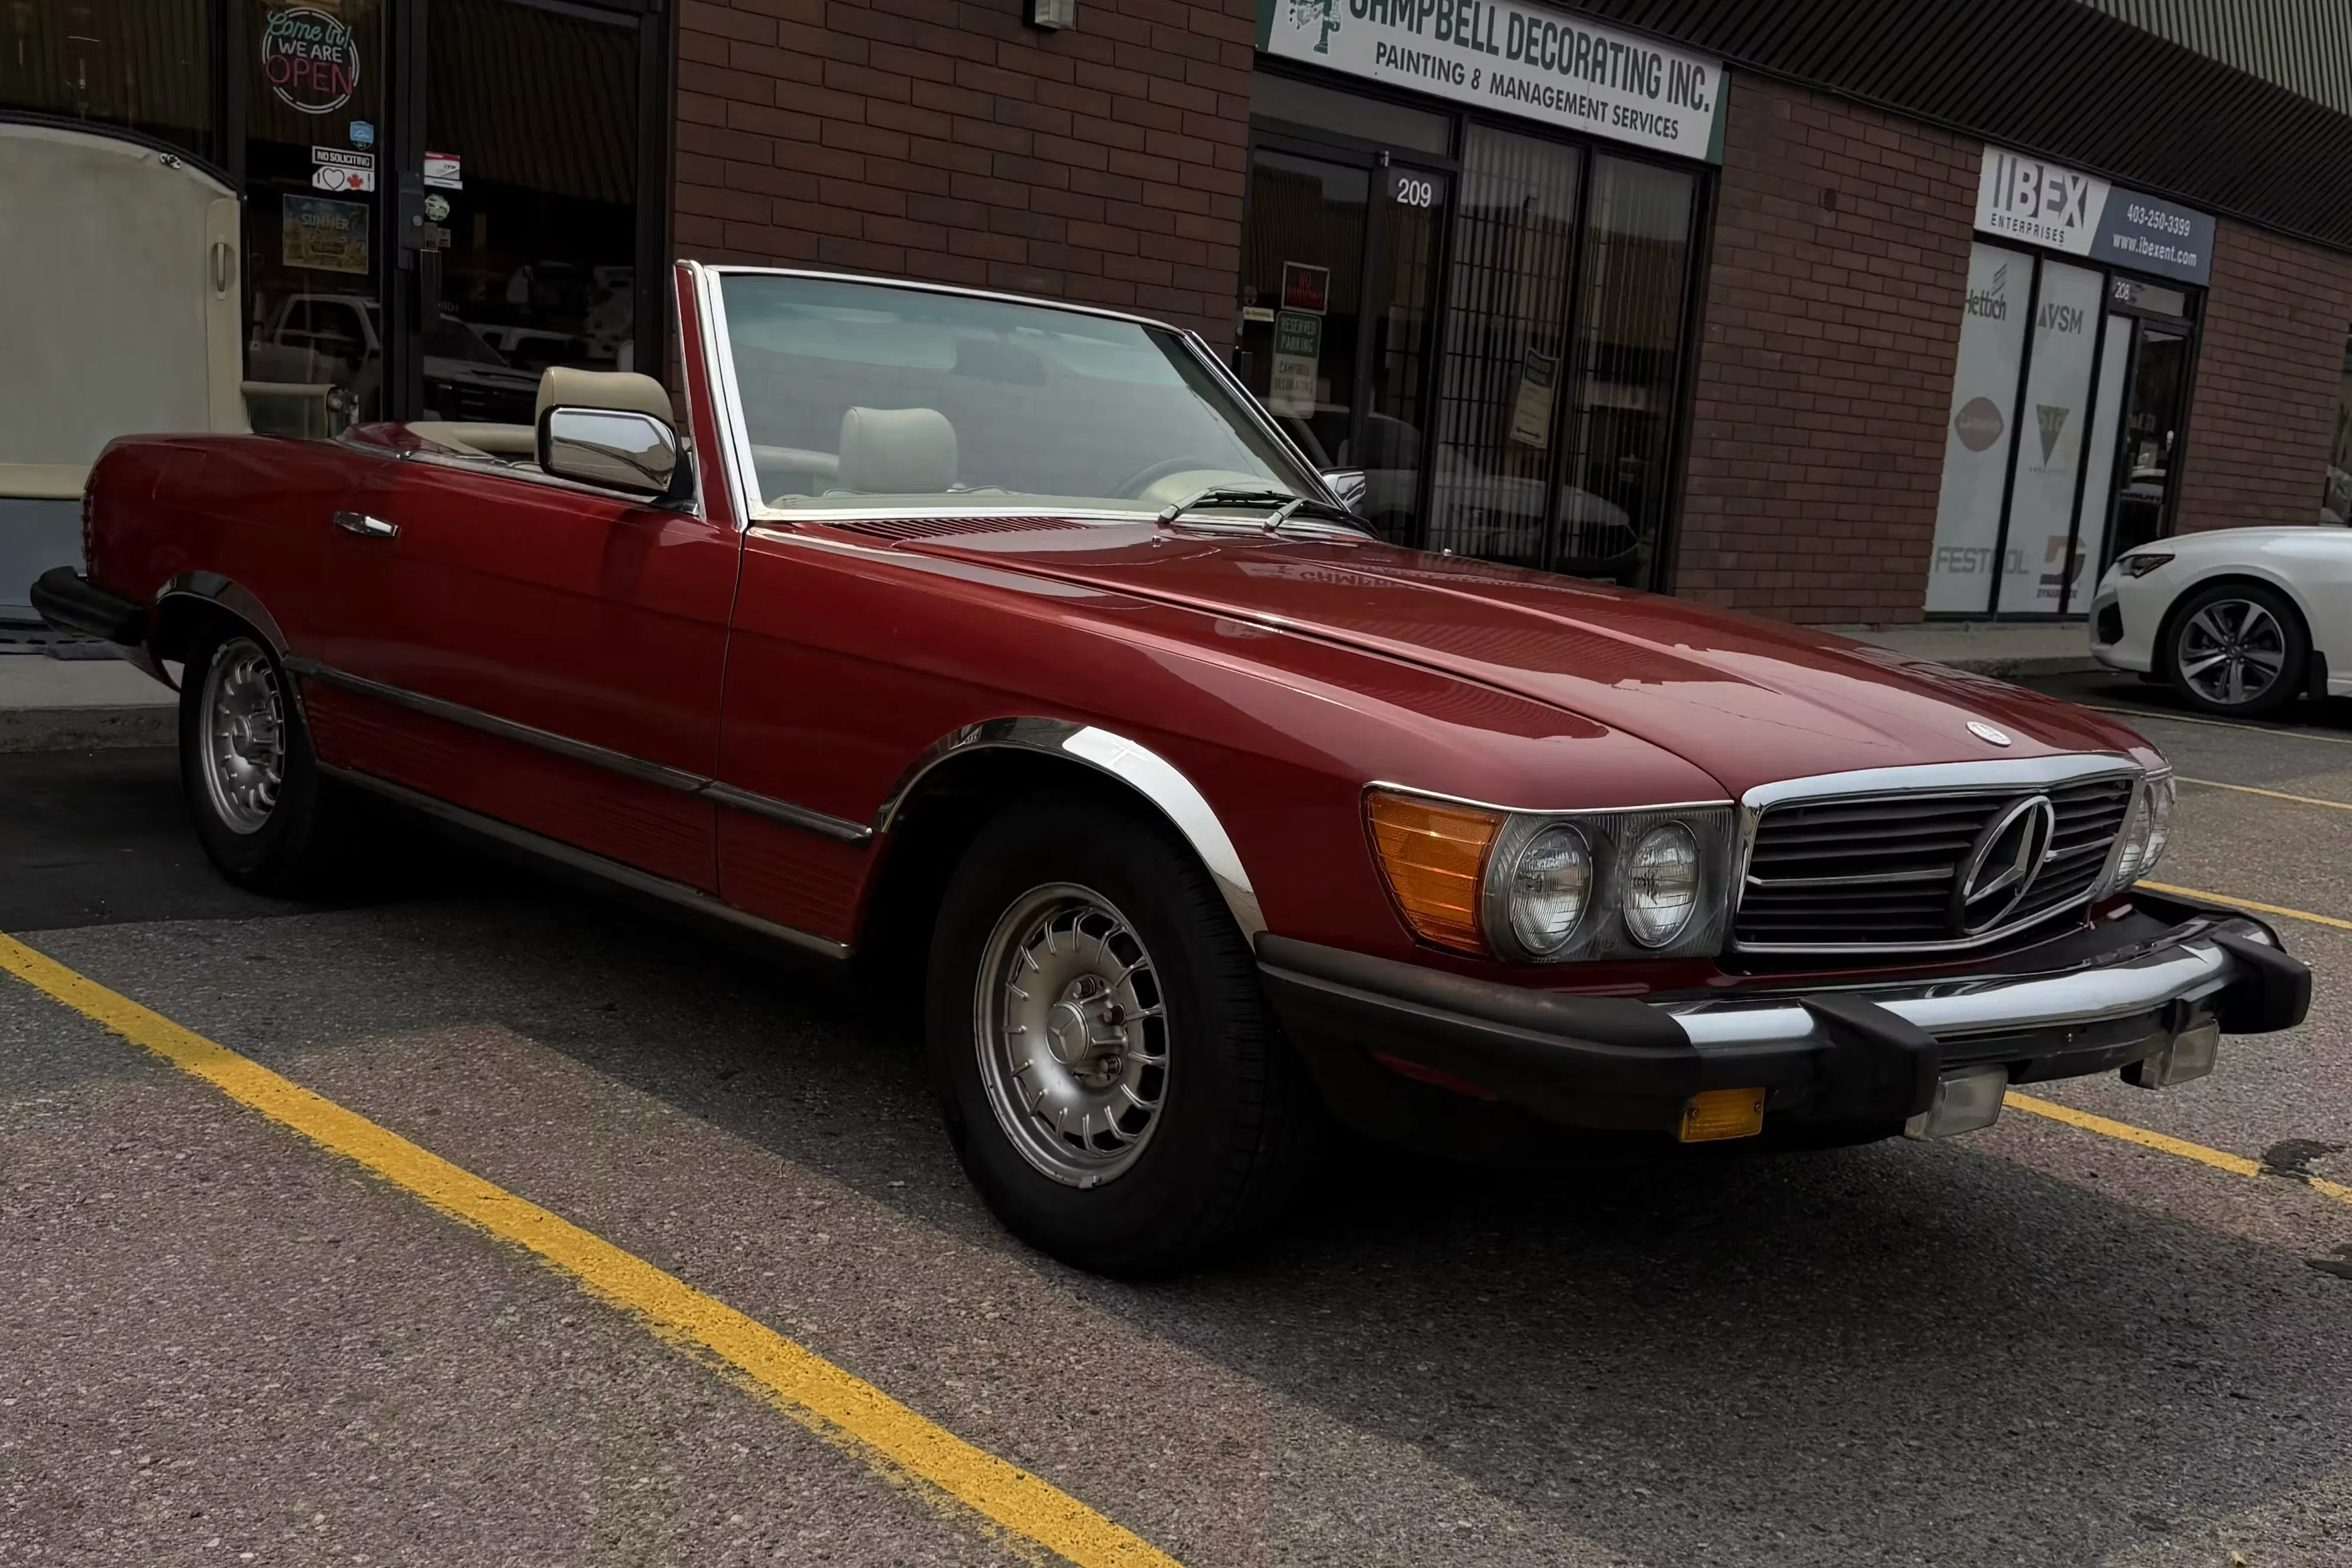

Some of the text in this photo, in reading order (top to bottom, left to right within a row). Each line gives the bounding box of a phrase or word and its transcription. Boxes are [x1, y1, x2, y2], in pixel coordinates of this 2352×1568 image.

[267, 11, 323, 42] Come
[278, 37, 344, 63] WE ARE
[1506, 11, 1663, 99] DECORATING
[1667, 59, 1710, 112] INC.
[265, 54, 353, 96] OPEN
[1376, 41, 1679, 140] PAINTING & MANAGEMENT SERVICES
[316, 150, 370, 167] NO SOLICITING
[1397, 177, 1432, 208] 209
[1993, 153, 2088, 229] IBEX
[300, 212, 350, 232] SUMMER
[1991, 213, 2065, 243] ENTERPRISES
[2127, 203, 2191, 237] 403-250-3399
[2113, 233, 2197, 267] www.ibexent.com
[1280, 316, 1317, 336] RESERVED
[2048, 303, 2084, 334] VSM
[1280, 335, 1314, 353] PARKING
[1935, 546, 2029, 575] FESTOL
